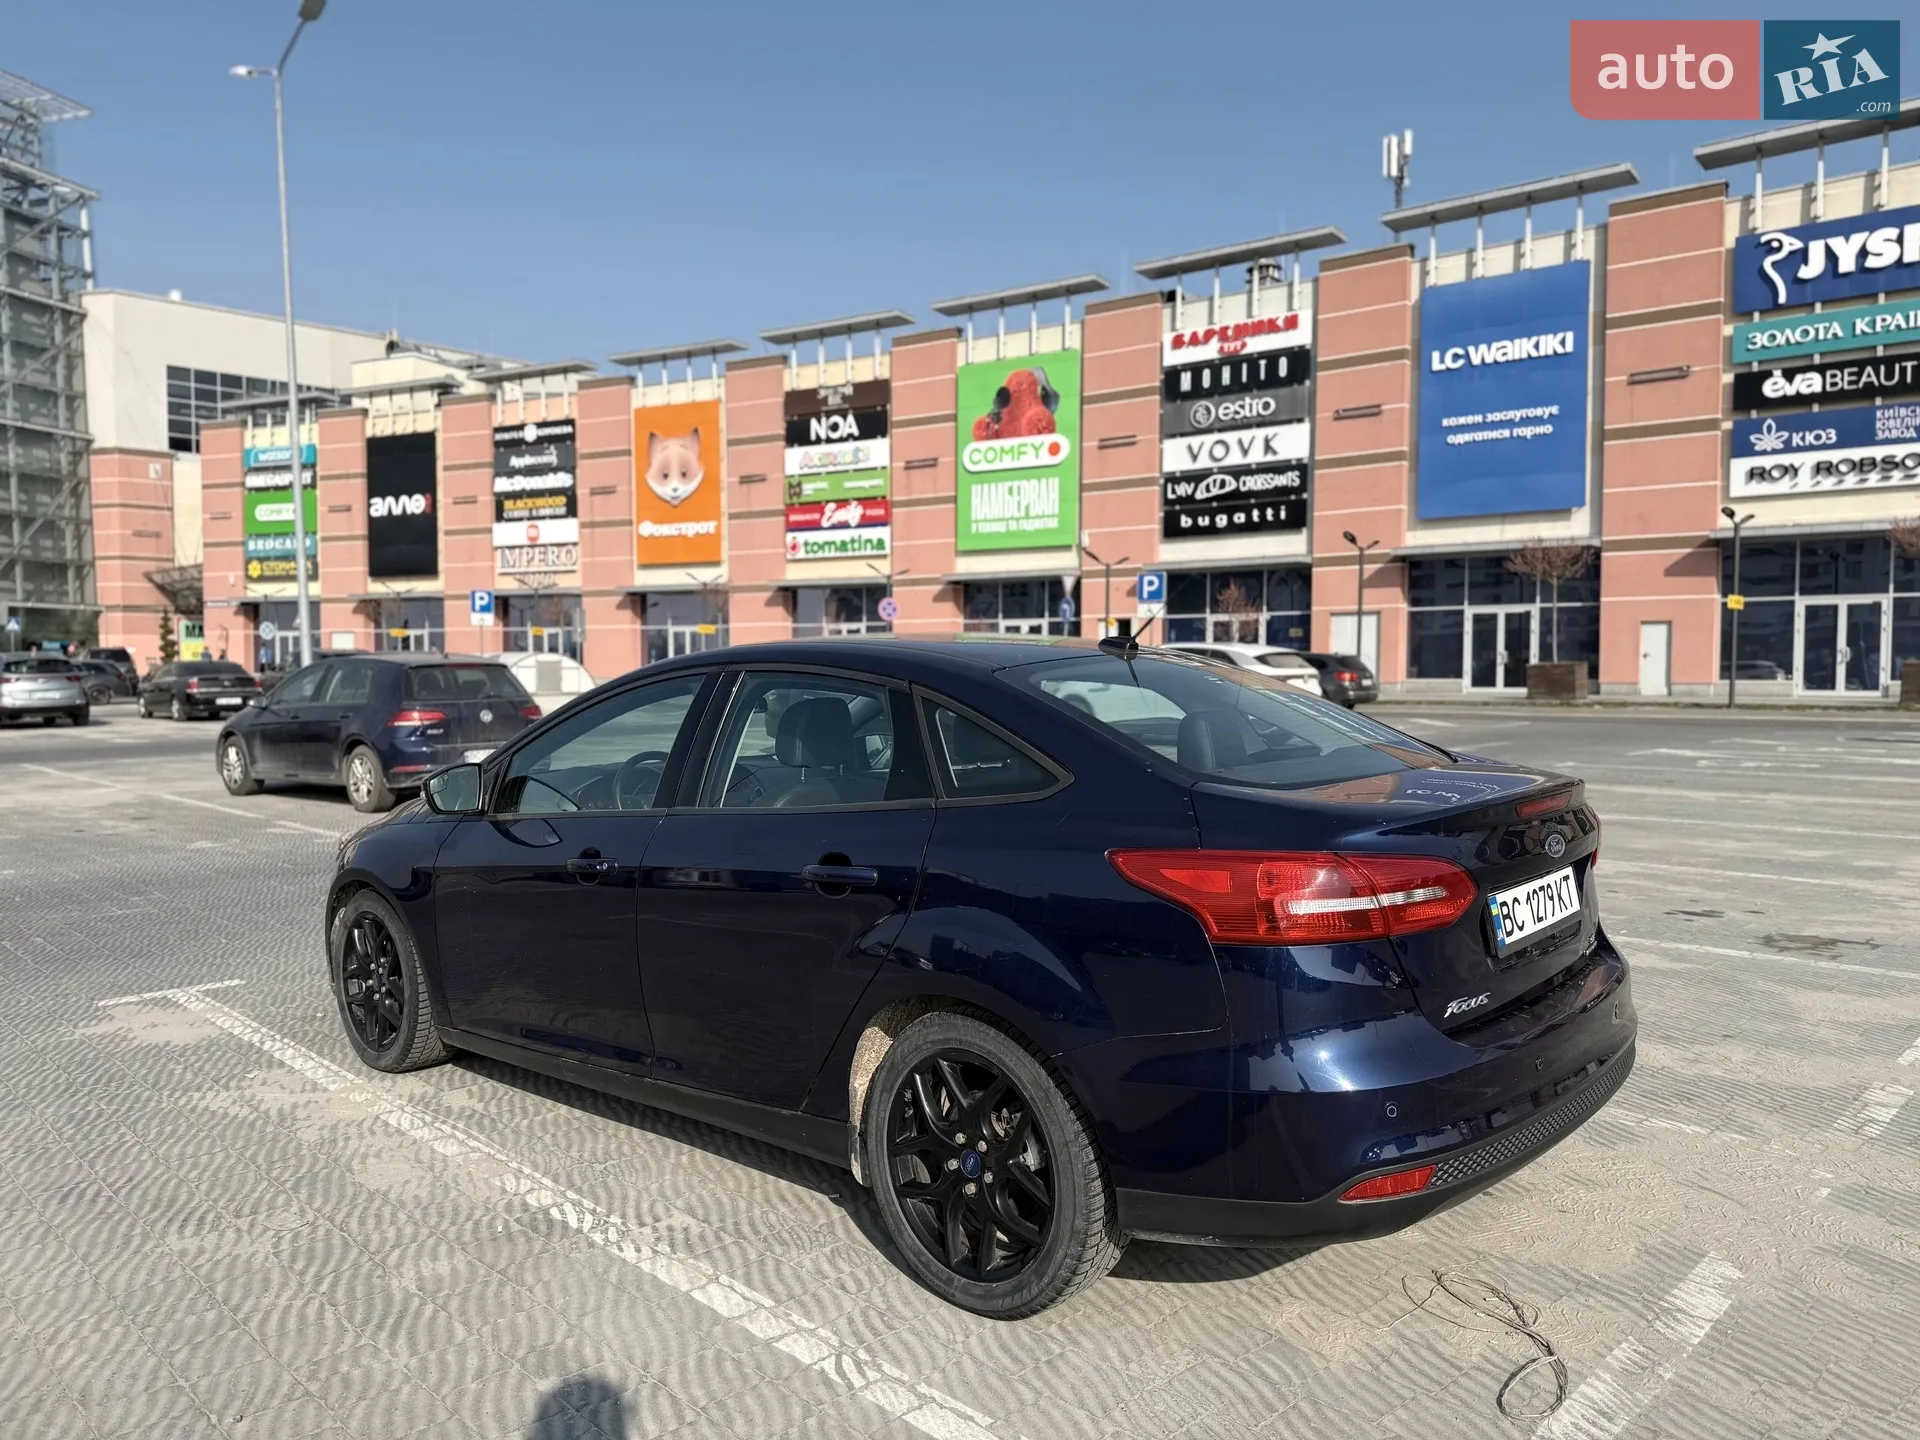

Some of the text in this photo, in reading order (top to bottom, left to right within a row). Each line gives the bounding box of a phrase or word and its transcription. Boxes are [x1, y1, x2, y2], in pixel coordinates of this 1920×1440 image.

[1747, 320, 1844, 350] ЗОЛОТА
[1431, 346, 1465, 372] LC
[1180, 356, 1288, 393] MOHITO
[1825, 361, 1920, 392] BEAUT
[1217, 396, 1276, 421] estro
[1442, 405, 1560, 428] кожен заслуговує
[809, 411, 860, 442] NOA
[1446, 424, 1554, 446] одягатися гарно
[1791, 427, 1837, 448] КЮЗ
[1875, 427, 1917, 441] ЗАВОД
[969, 441, 1044, 465] COMFY
[1186, 432, 1279, 464] VOVK
[493, 471, 574, 493] McDonald's
[1239, 470, 1301, 492] CROISSANTS
[1746, 461, 1804, 484] ROY
[971, 477, 1059, 521] НАМБЕРВАН
[1180, 504, 1287, 528] bugatti
[247, 537, 312, 551] BROCAD
[803, 534, 887, 555] tomatina
[499, 545, 577, 569] IMPERO
[1142, 575, 1160, 599] P
[474, 591, 490, 612] P
[1499, 874, 1573, 938] BC 1279 KT
[1444, 992, 1491, 1018] Focus
